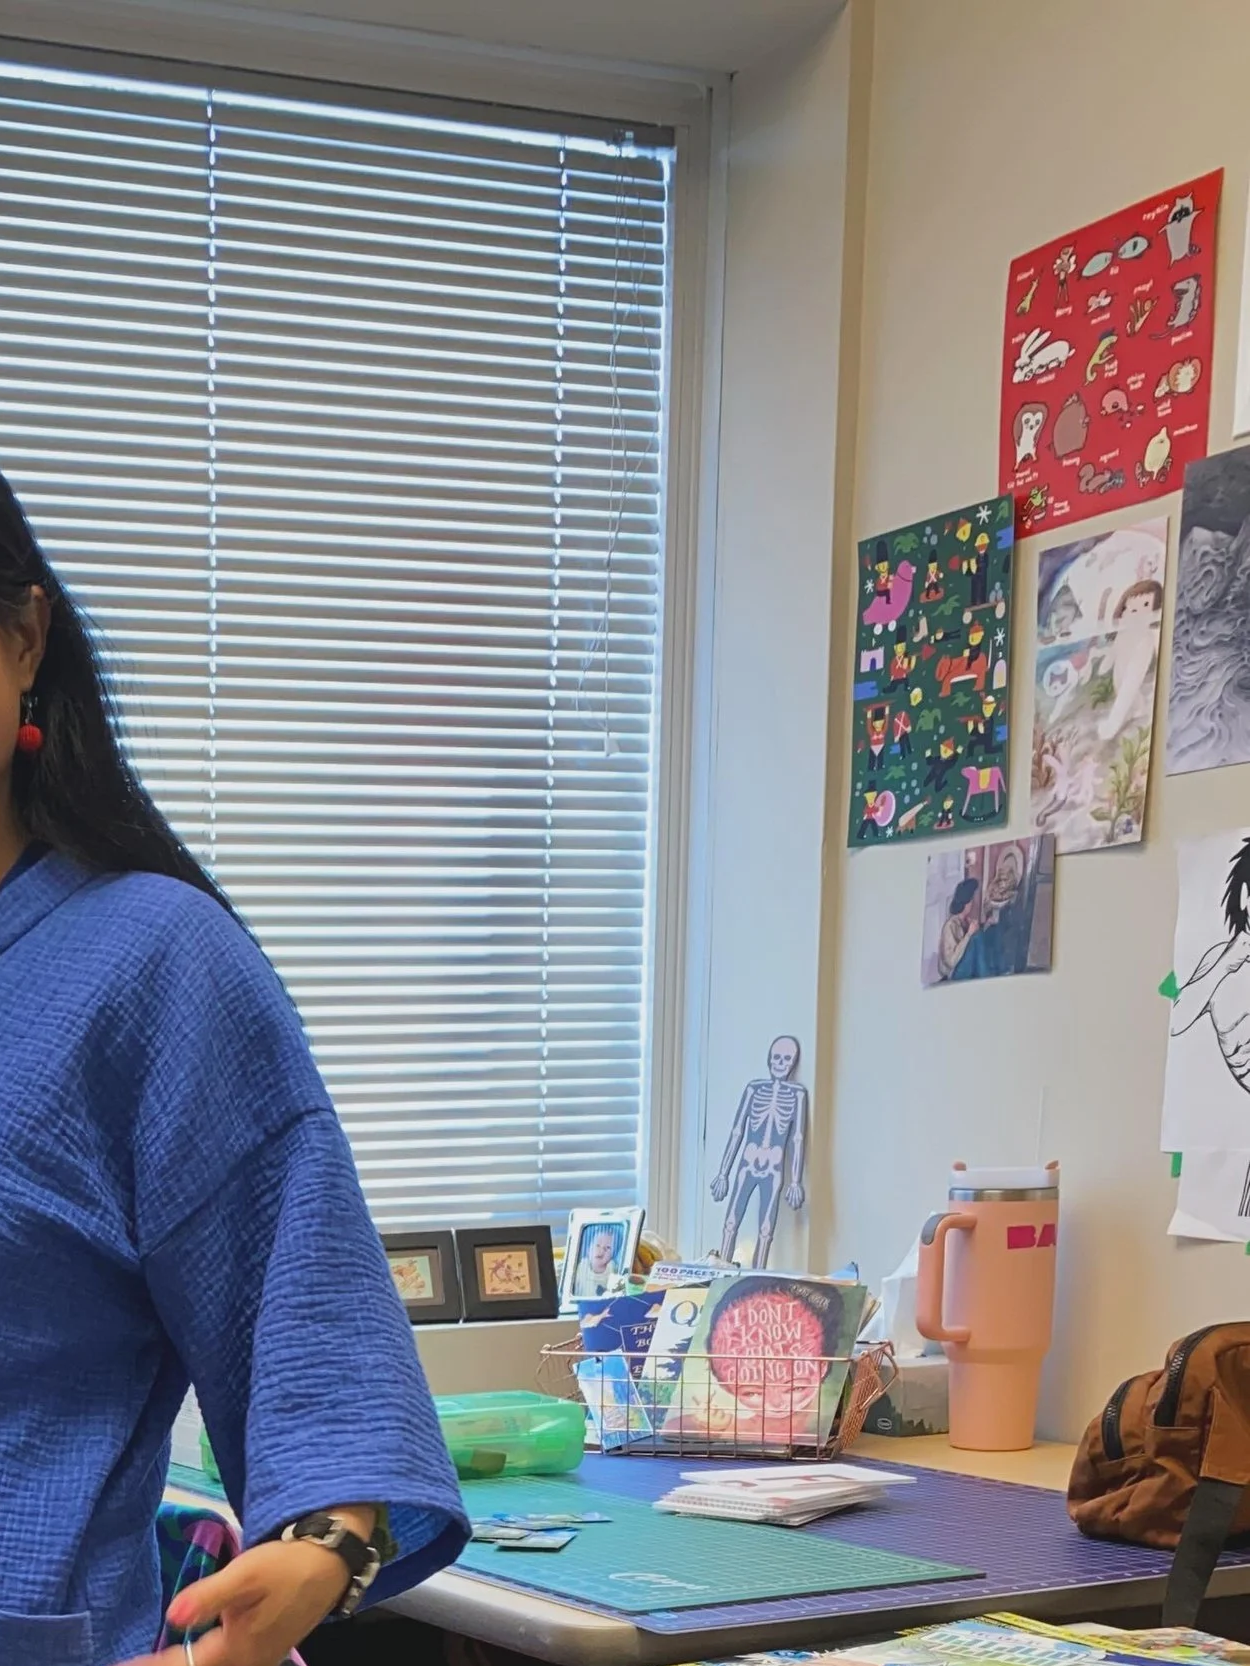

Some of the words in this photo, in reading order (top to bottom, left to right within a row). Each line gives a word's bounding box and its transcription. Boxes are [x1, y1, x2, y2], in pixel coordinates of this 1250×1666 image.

[655, 1266, 678, 1275] 100
[670, 1300, 703, 1327] Q
[734, 1308, 741, 1327] I
[740, 1321, 802, 1347] KNOW
[793, 1360, 819, 1377] ON
